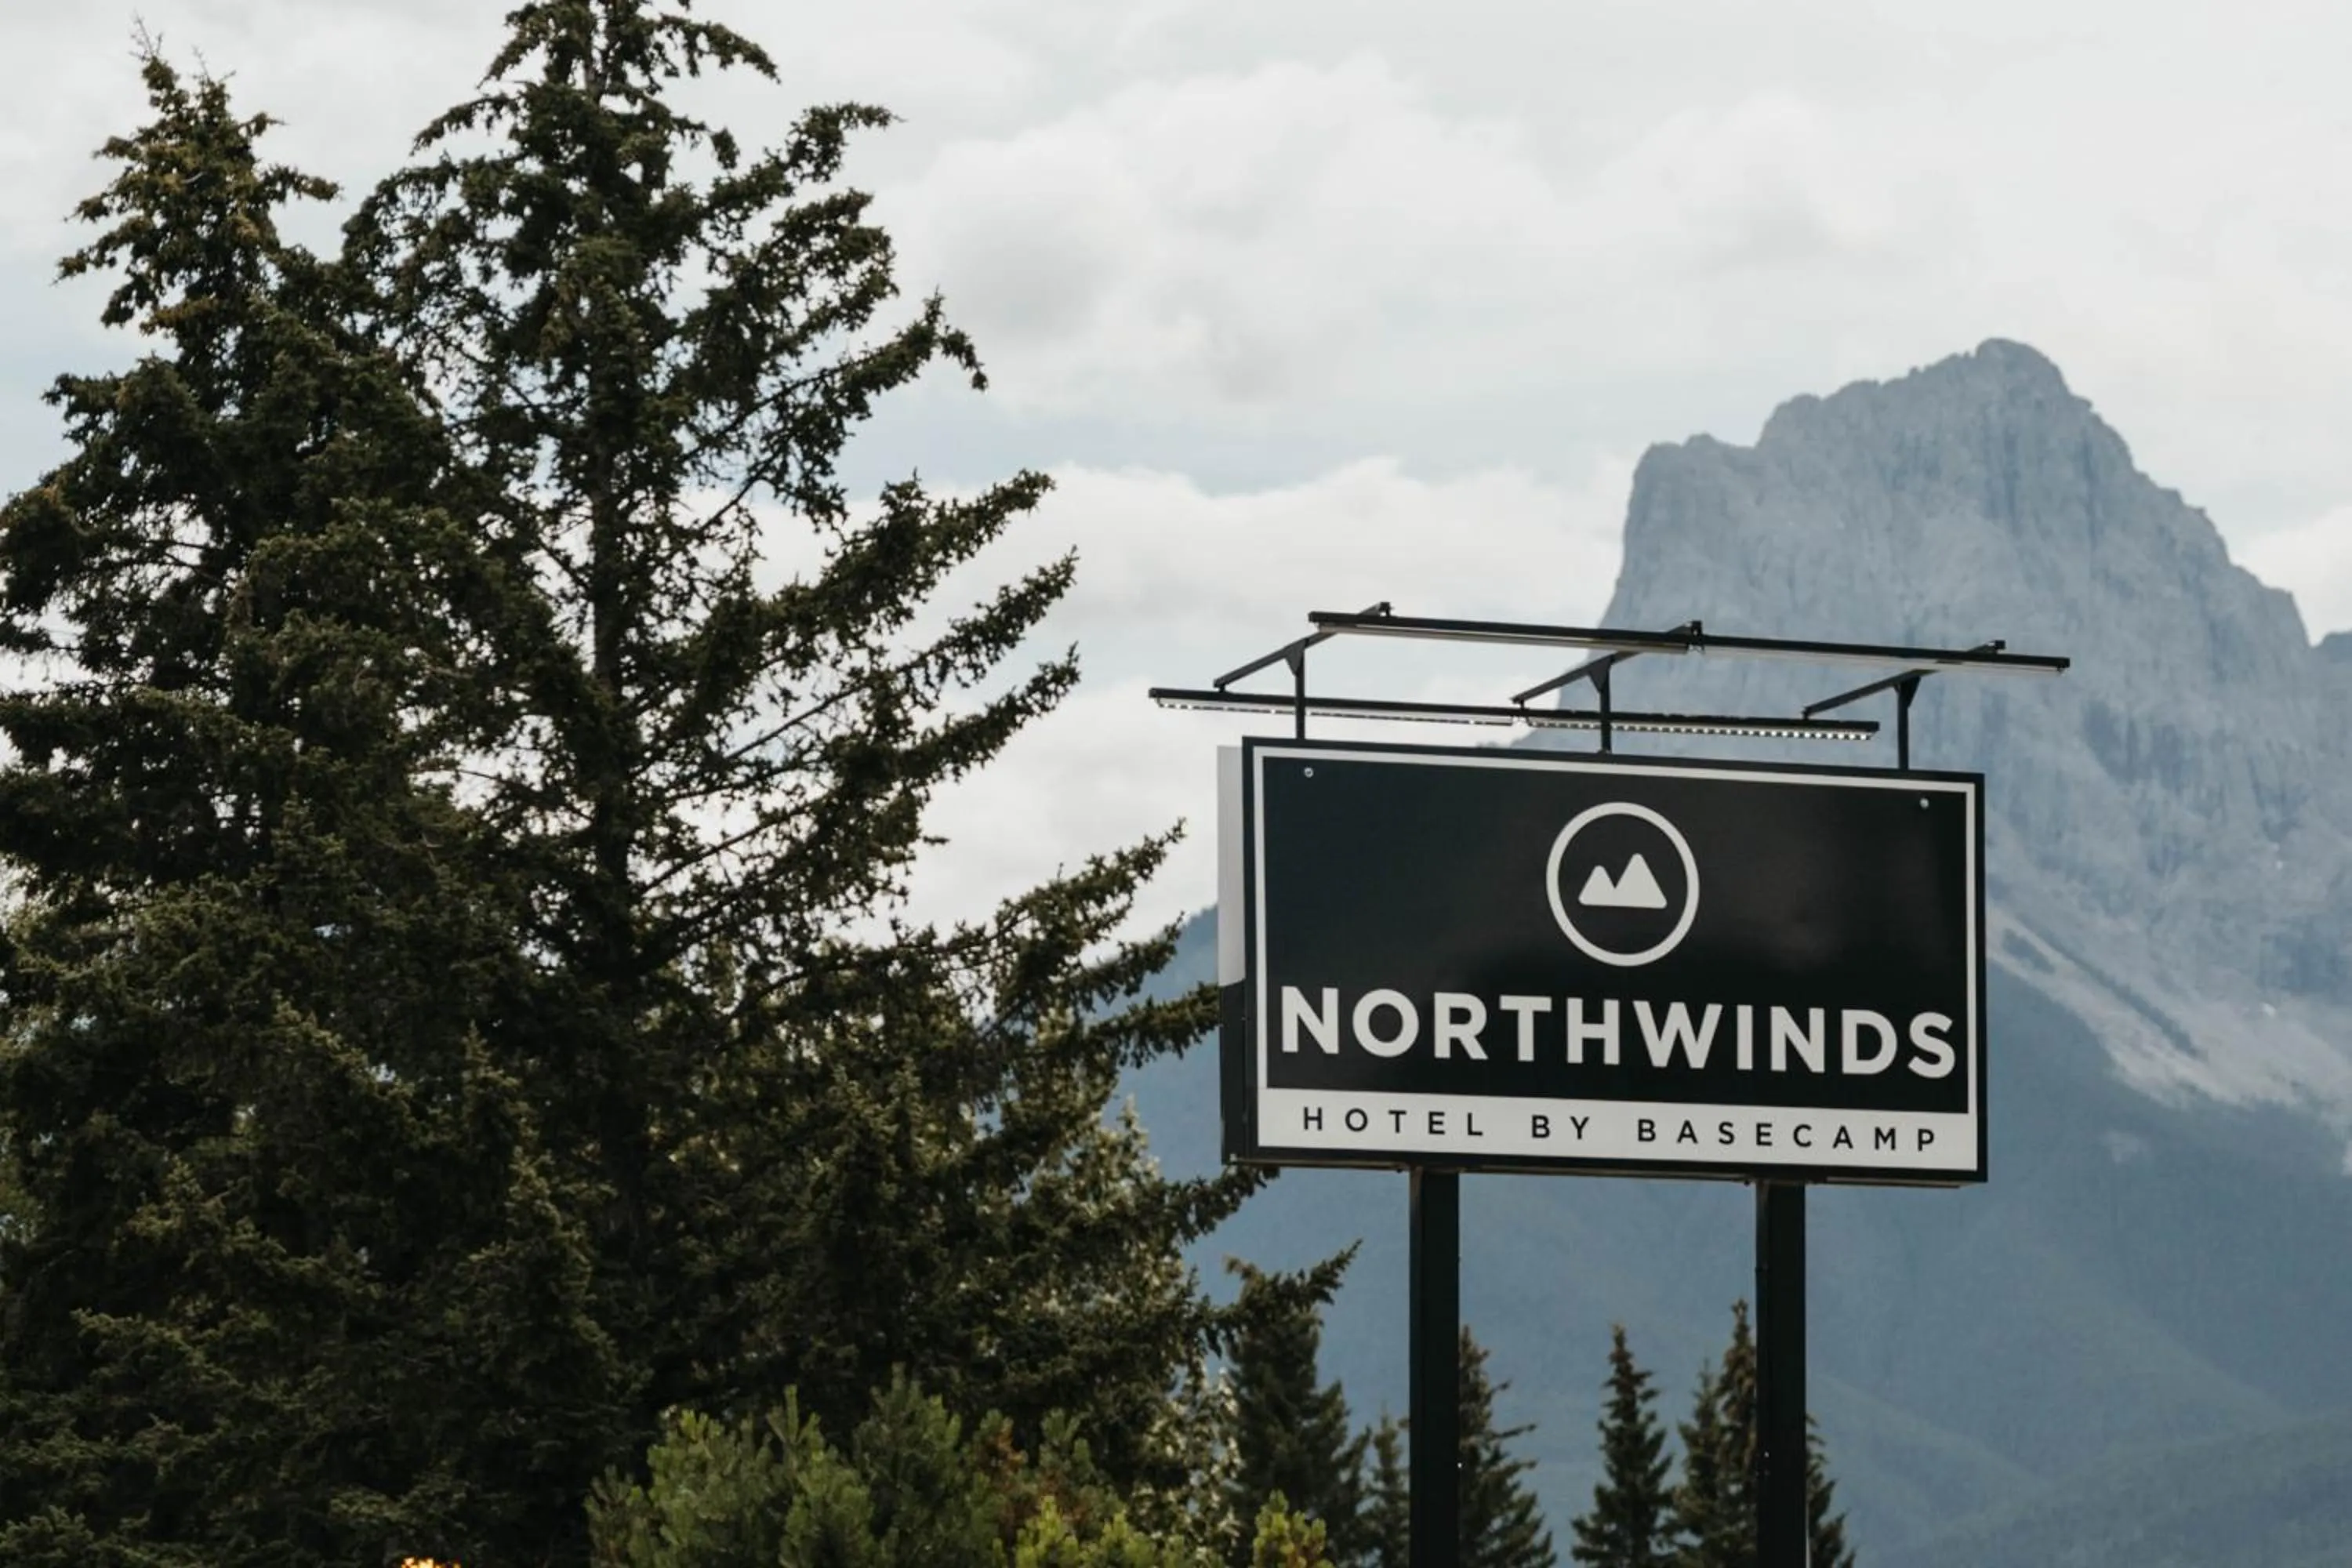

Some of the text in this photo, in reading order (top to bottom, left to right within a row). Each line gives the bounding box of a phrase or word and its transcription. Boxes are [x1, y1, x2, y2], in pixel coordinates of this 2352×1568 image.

[1280, 985, 1956, 1079] NORTHWINDS
[1303, 1106, 1936, 1152] HOTEL BY BASECAMP
